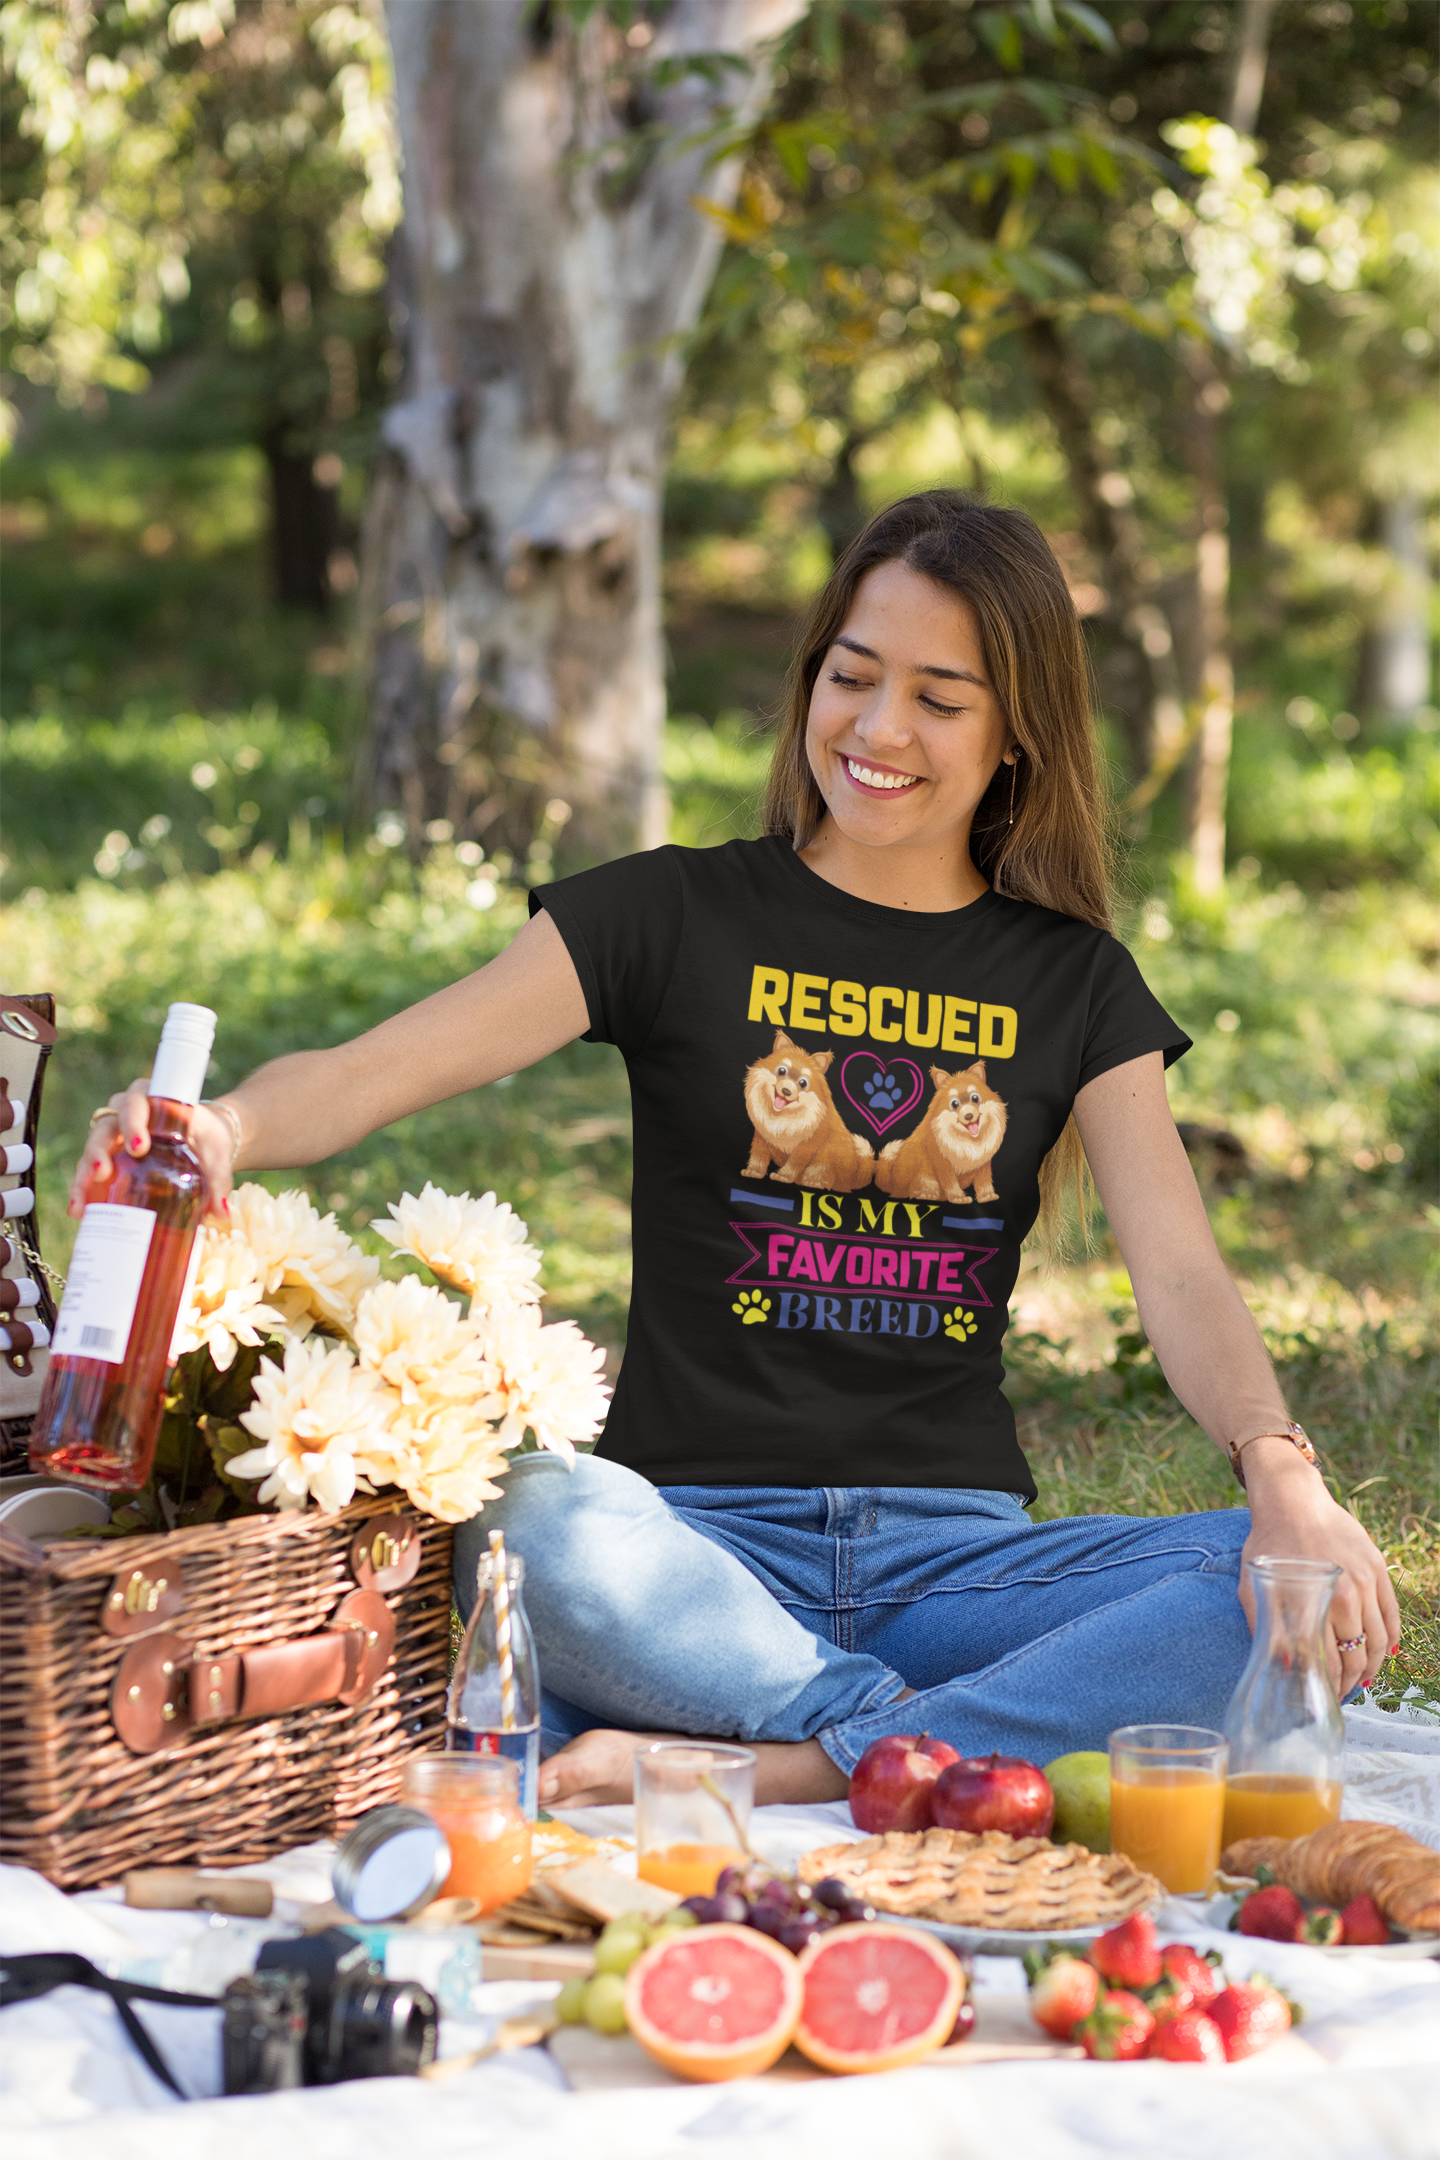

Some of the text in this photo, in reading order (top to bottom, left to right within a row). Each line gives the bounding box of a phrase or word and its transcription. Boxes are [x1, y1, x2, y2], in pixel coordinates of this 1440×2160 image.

[748, 965, 1018, 1059] RESCUED
[798, 1191, 940, 1238] IS MY
[768, 1234, 965, 1293] FAVORITE
[775, 1292, 940, 1338] BREED
